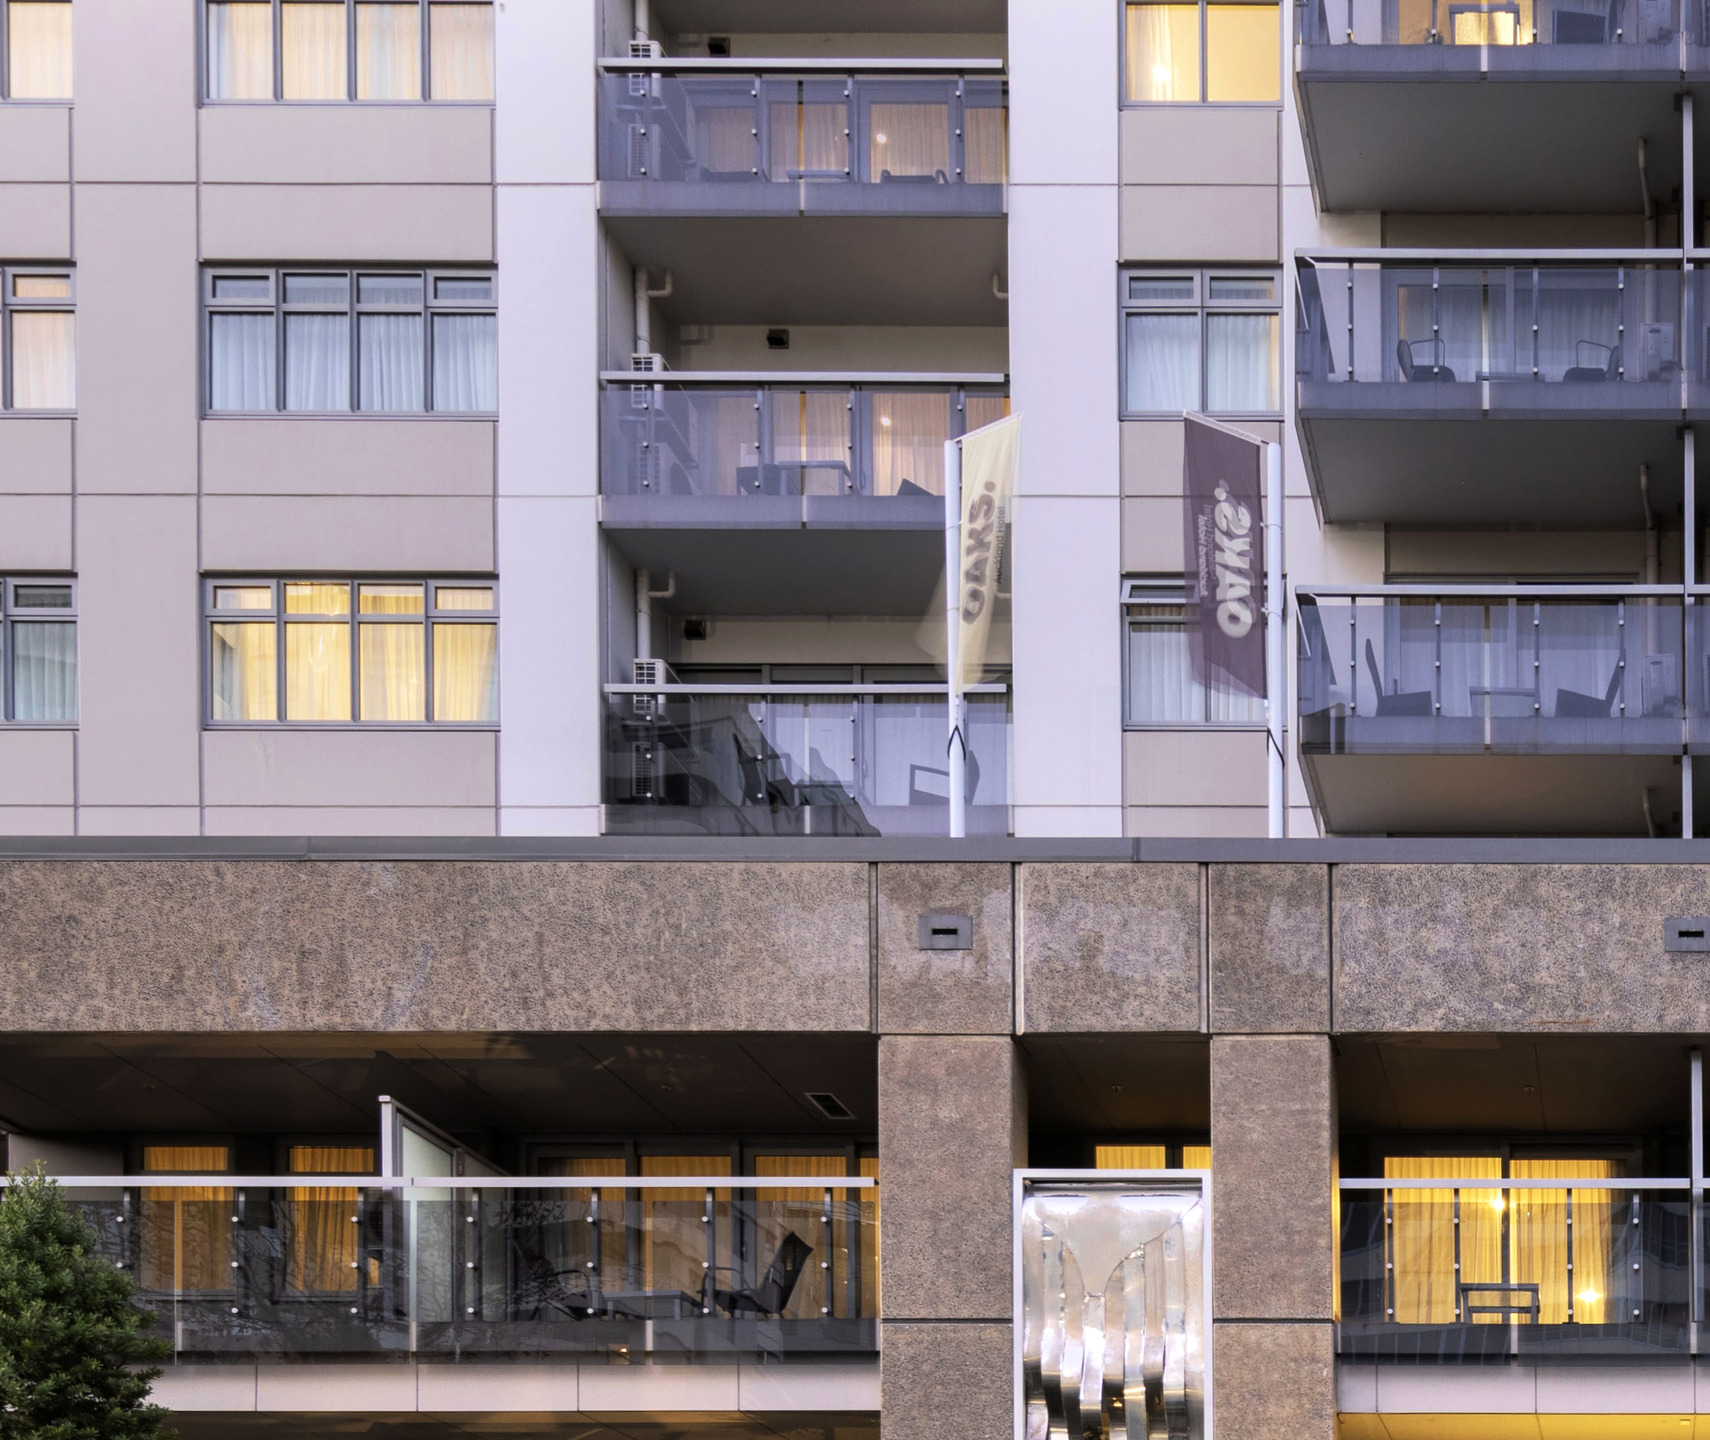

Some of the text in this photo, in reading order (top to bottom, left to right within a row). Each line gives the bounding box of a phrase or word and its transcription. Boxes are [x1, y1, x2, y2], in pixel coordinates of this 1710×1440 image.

[962, 481, 996, 624] OAKS.
[994, 506, 1006, 585] Auckland Hotel
